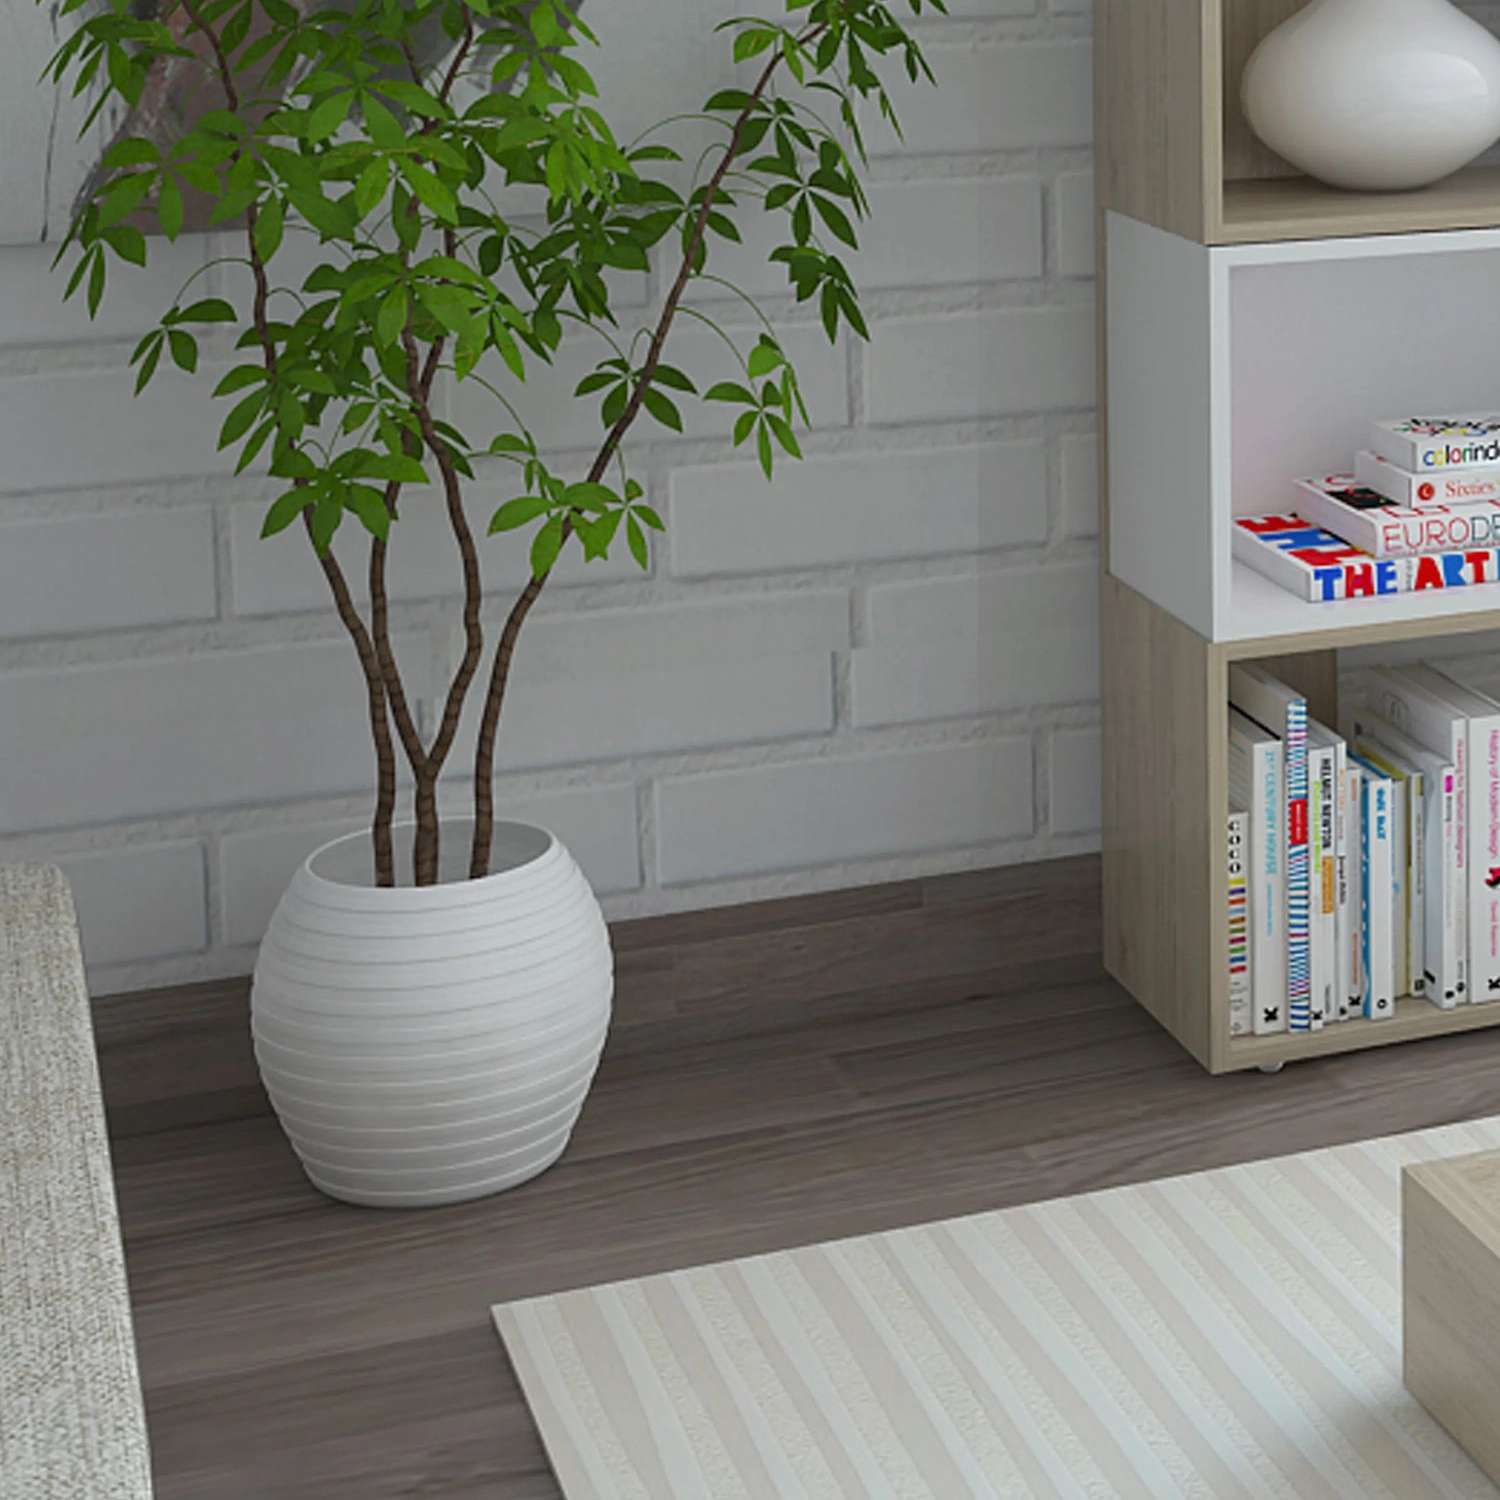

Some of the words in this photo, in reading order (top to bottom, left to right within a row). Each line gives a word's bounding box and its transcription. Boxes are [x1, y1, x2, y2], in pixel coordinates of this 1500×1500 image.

[1313, 560, 1399, 601] THE
[1414, 551, 1490, 591] ART
[1488, 730, 1499, 766] History
[1487, 821, 1500, 859] Design
